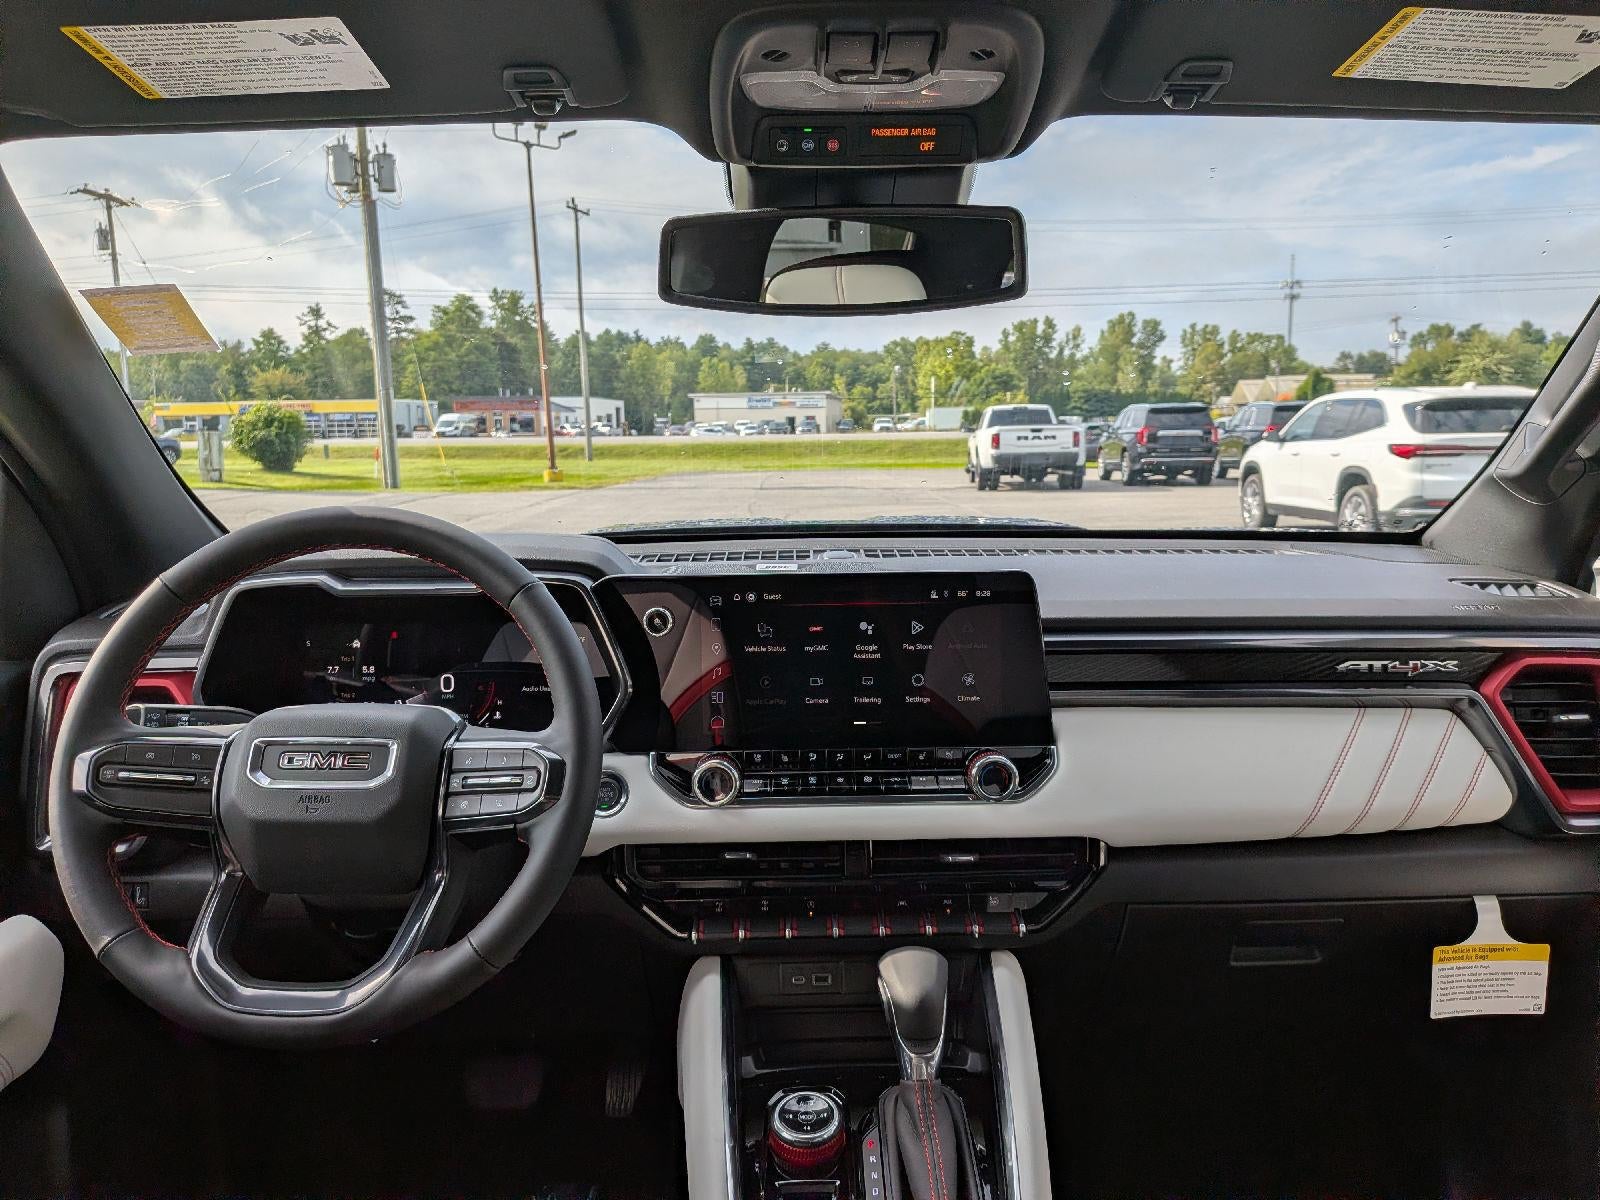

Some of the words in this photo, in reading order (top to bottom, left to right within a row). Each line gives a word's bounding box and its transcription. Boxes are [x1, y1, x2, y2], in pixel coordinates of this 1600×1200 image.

[871, 128, 909, 136] PASSENGER
[910, 128, 921, 136] AIR
[922, 128, 936, 136] BAG
[920, 142, 935, 150] OFF
[1335, 660, 1459, 678] AT4X
[440, 674, 454, 692] 0
[279, 752, 372, 770] GMC
[298, 794, 331, 804] AIRBAG
[872, 1188, 879, 1196] D
